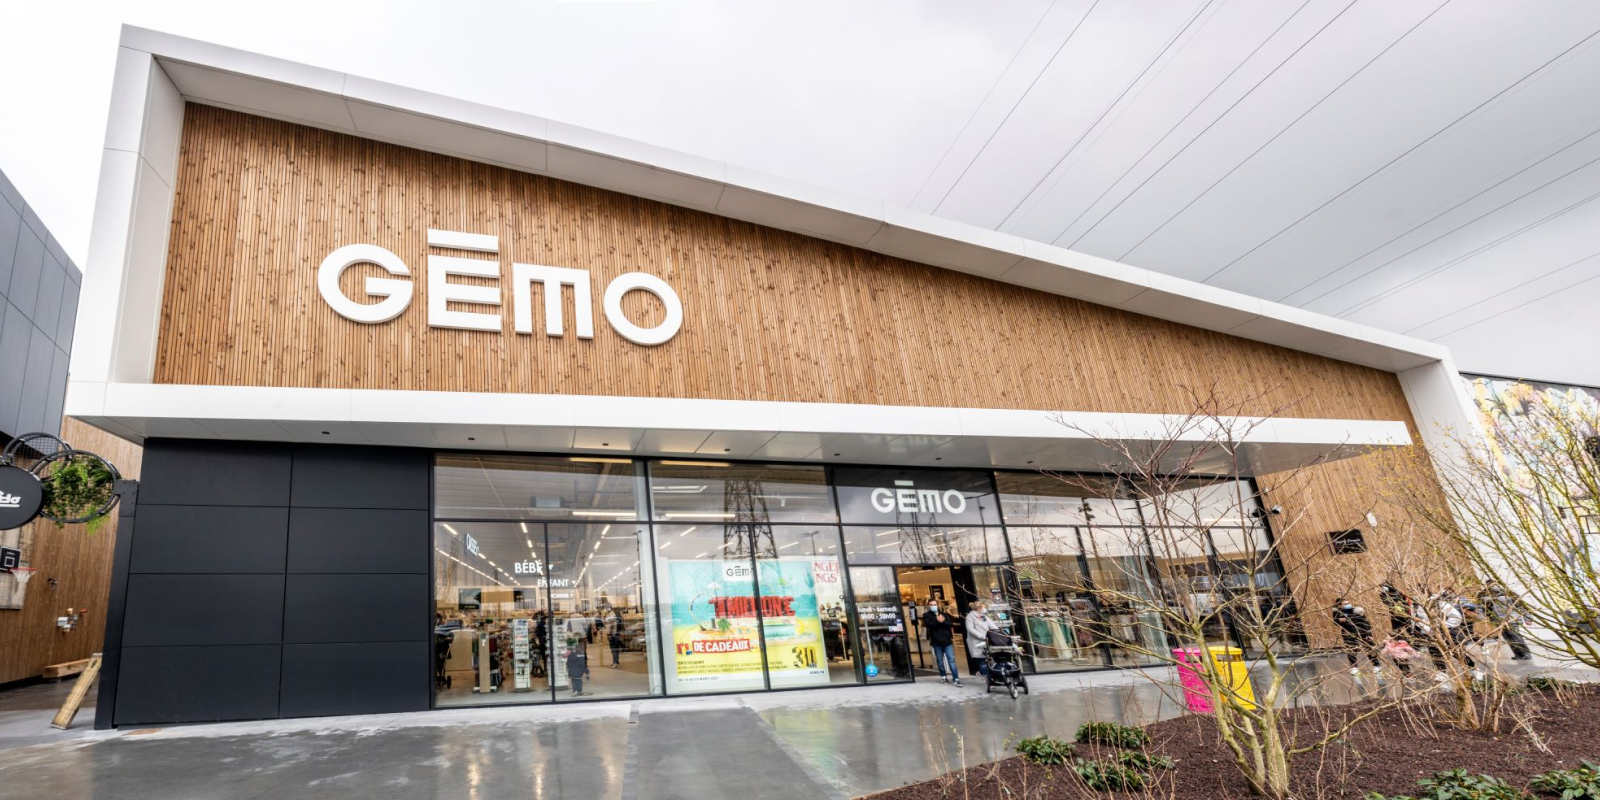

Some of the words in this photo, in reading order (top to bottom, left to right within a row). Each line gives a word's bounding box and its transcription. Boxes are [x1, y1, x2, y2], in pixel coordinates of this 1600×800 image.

[514, 559, 543, 573] BÉBÉ
[537, 579, 569, 587] ENFANT
[727, 595, 782, 618] MILLON
[693, 641, 704, 652] DE
[705, 640, 749, 652] CADEAUX
